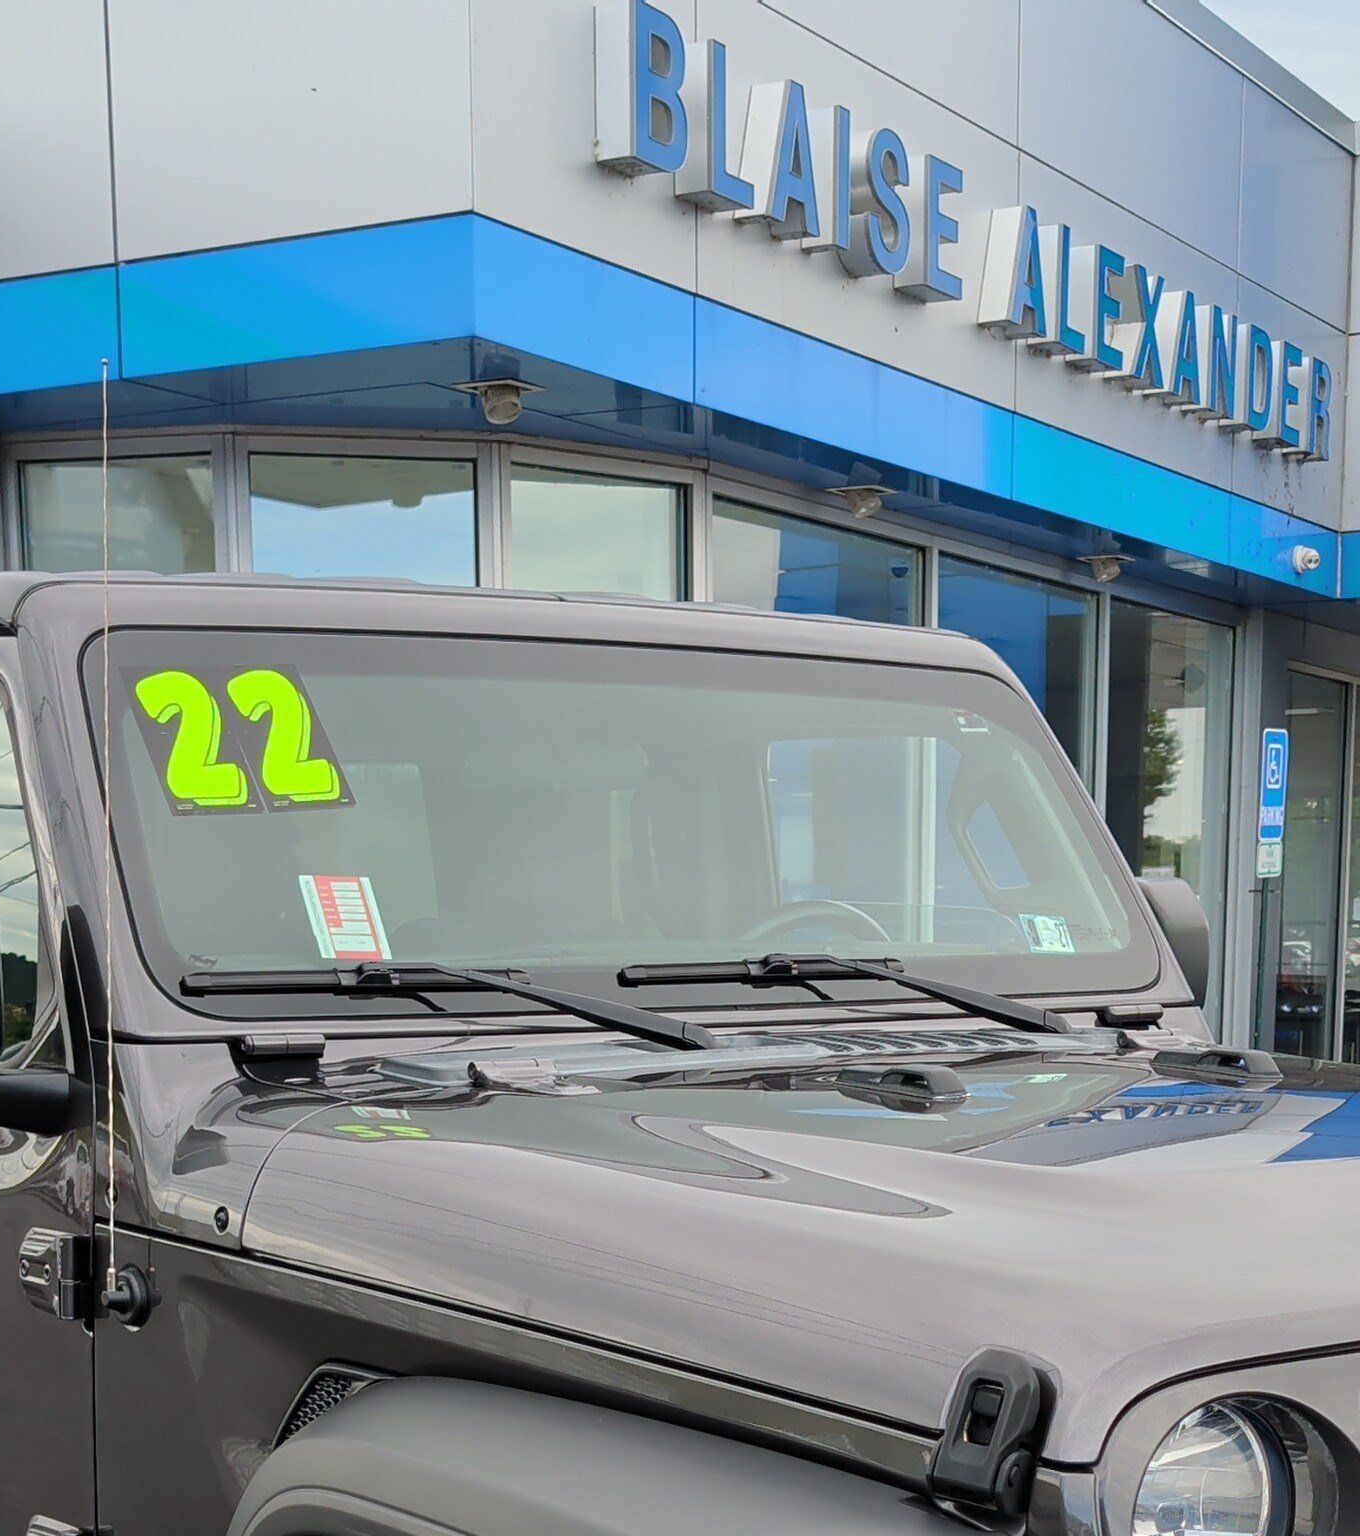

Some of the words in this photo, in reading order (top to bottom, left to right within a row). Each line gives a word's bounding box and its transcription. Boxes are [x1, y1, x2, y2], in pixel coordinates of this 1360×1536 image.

[630, 0, 964, 302] BLAISE
[1006, 204, 1333, 463] ALEXANDER
[134, 669, 341, 807] 22
